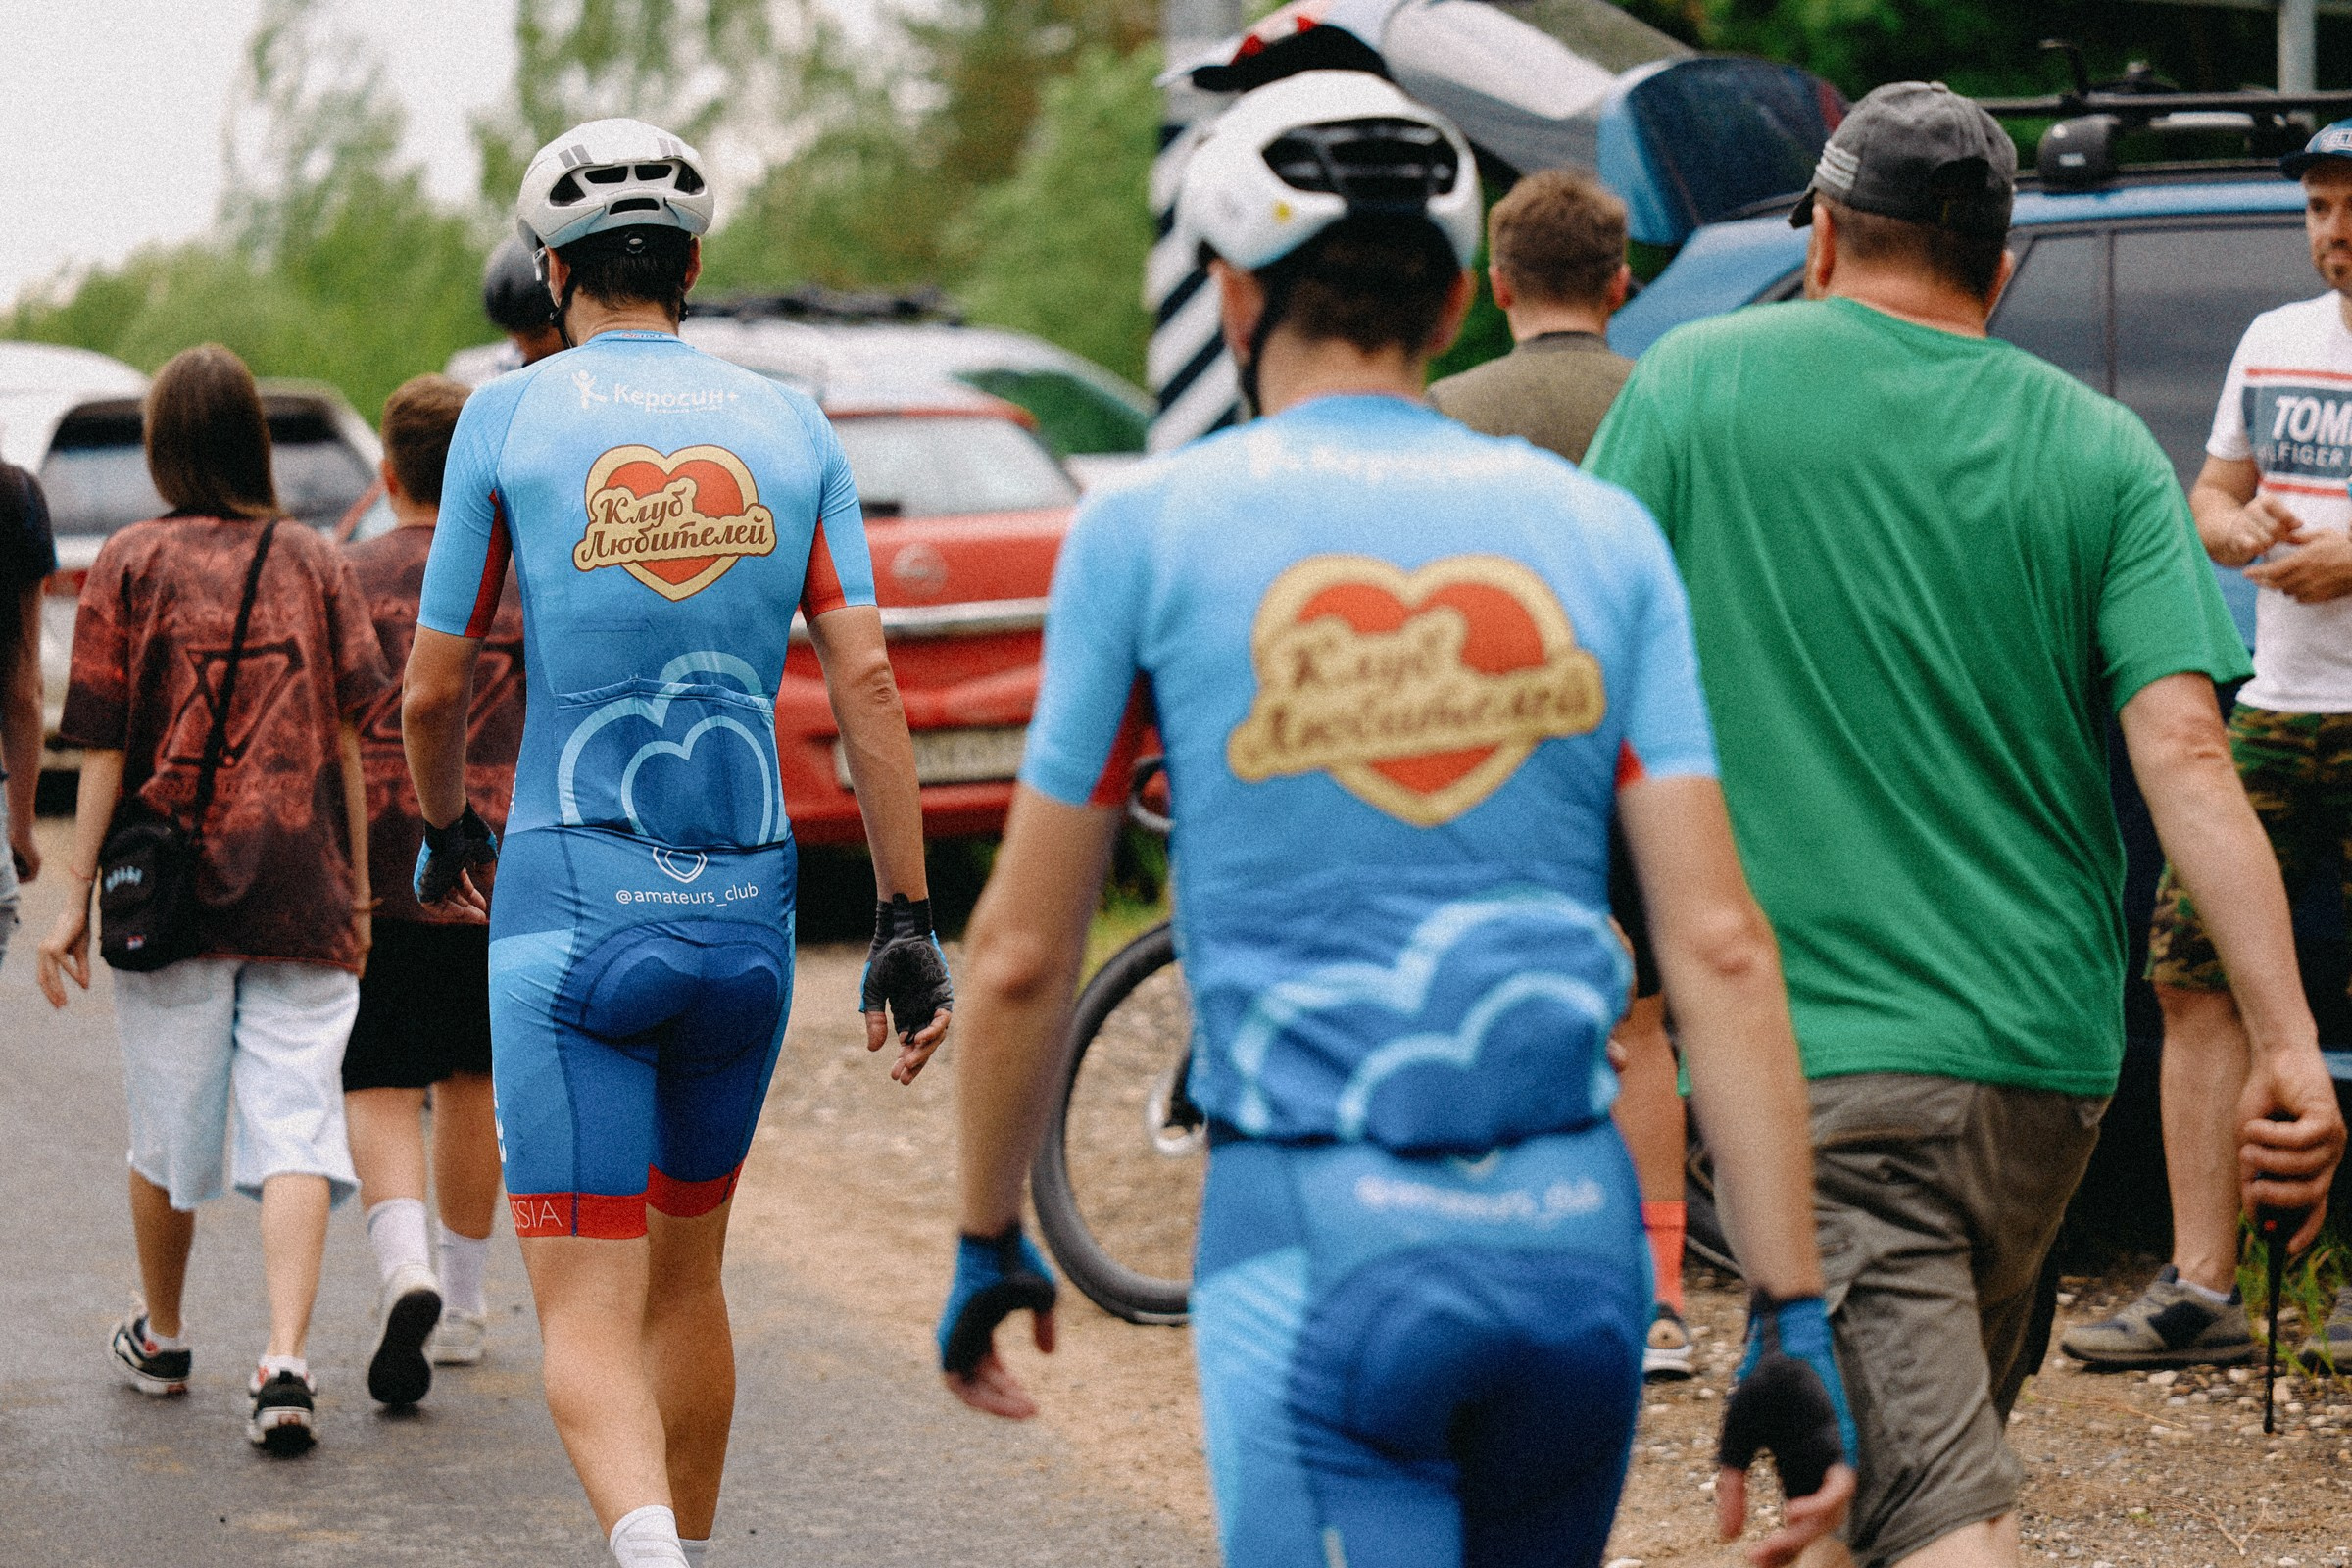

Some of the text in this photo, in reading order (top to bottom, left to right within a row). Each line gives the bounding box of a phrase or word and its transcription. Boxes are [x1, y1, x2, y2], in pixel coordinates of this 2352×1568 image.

[2272, 395, 2352, 446] TOM
[600, 486, 687, 528] Клуб
[581, 515, 768, 562] Любителей
[615, 882, 759, 907] @amateurs_club
